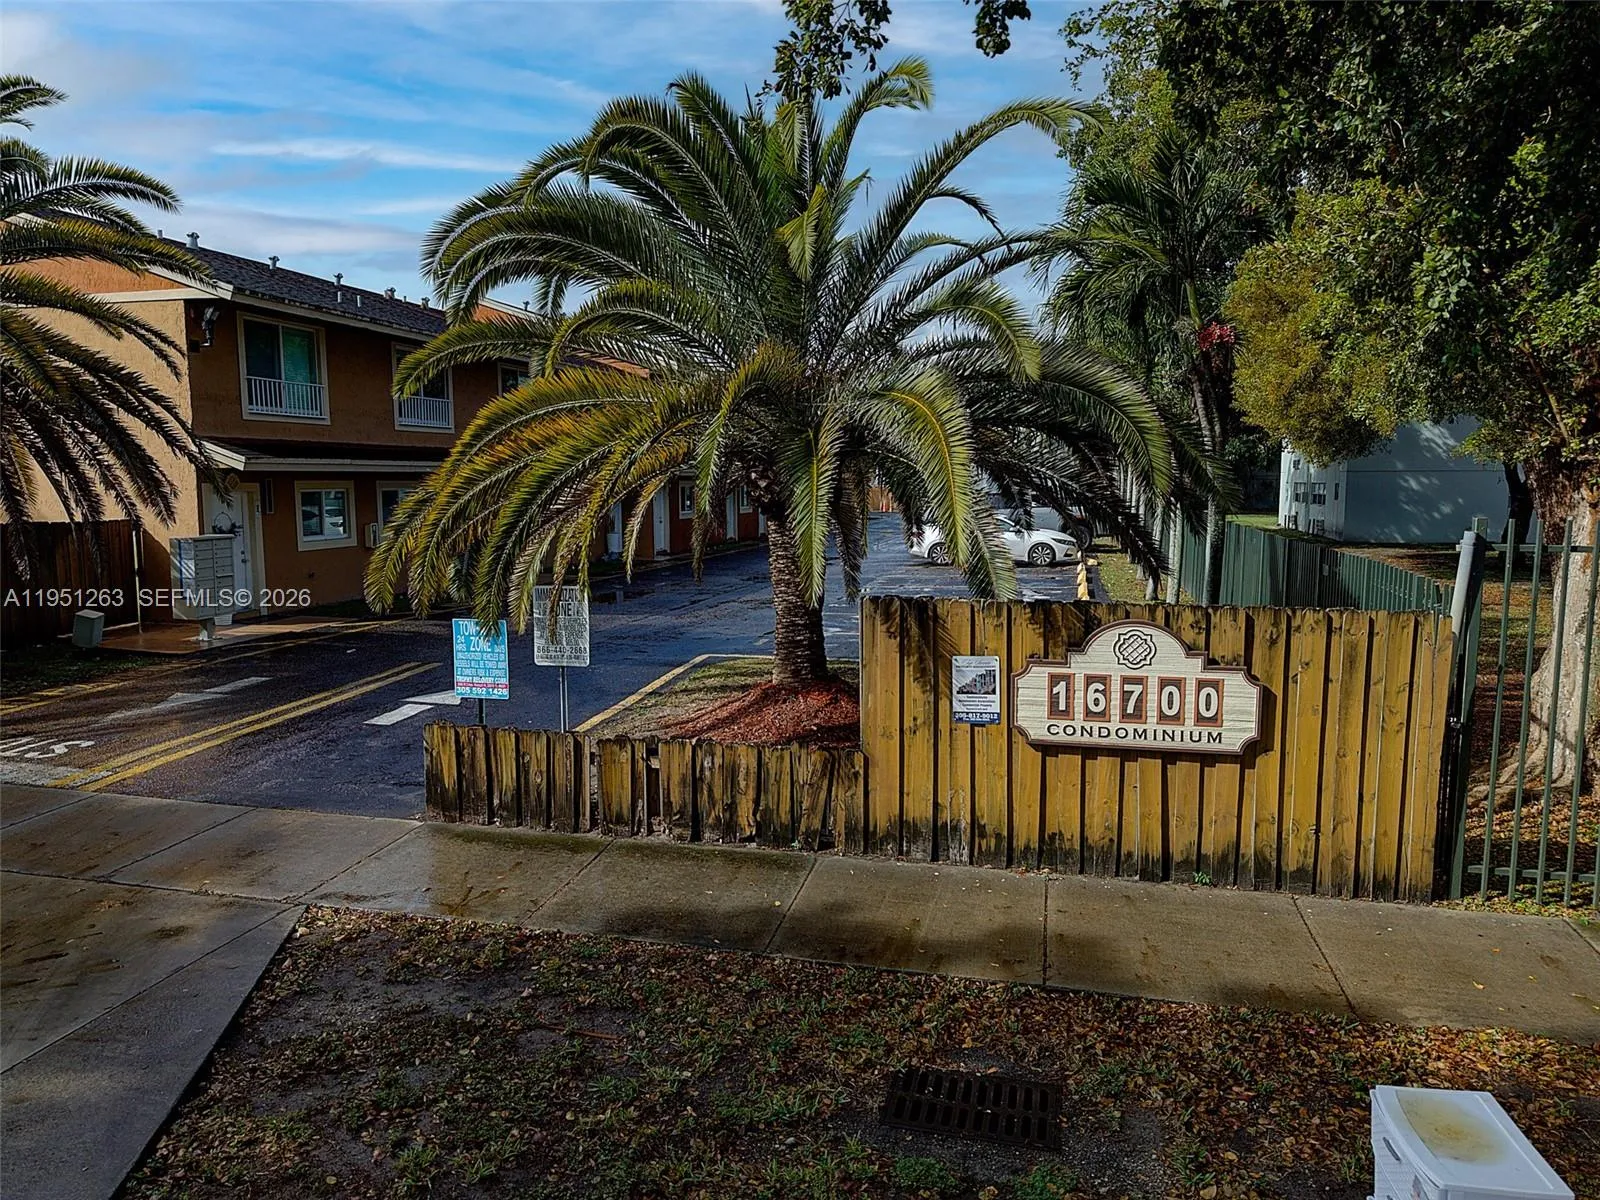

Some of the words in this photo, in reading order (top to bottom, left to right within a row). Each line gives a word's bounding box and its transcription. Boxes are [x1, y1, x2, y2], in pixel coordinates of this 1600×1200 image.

[456, 686, 471, 694] 305
[1052, 681, 1219, 718] 16700
[1047, 723, 1222, 744] CONDOMINIUM
